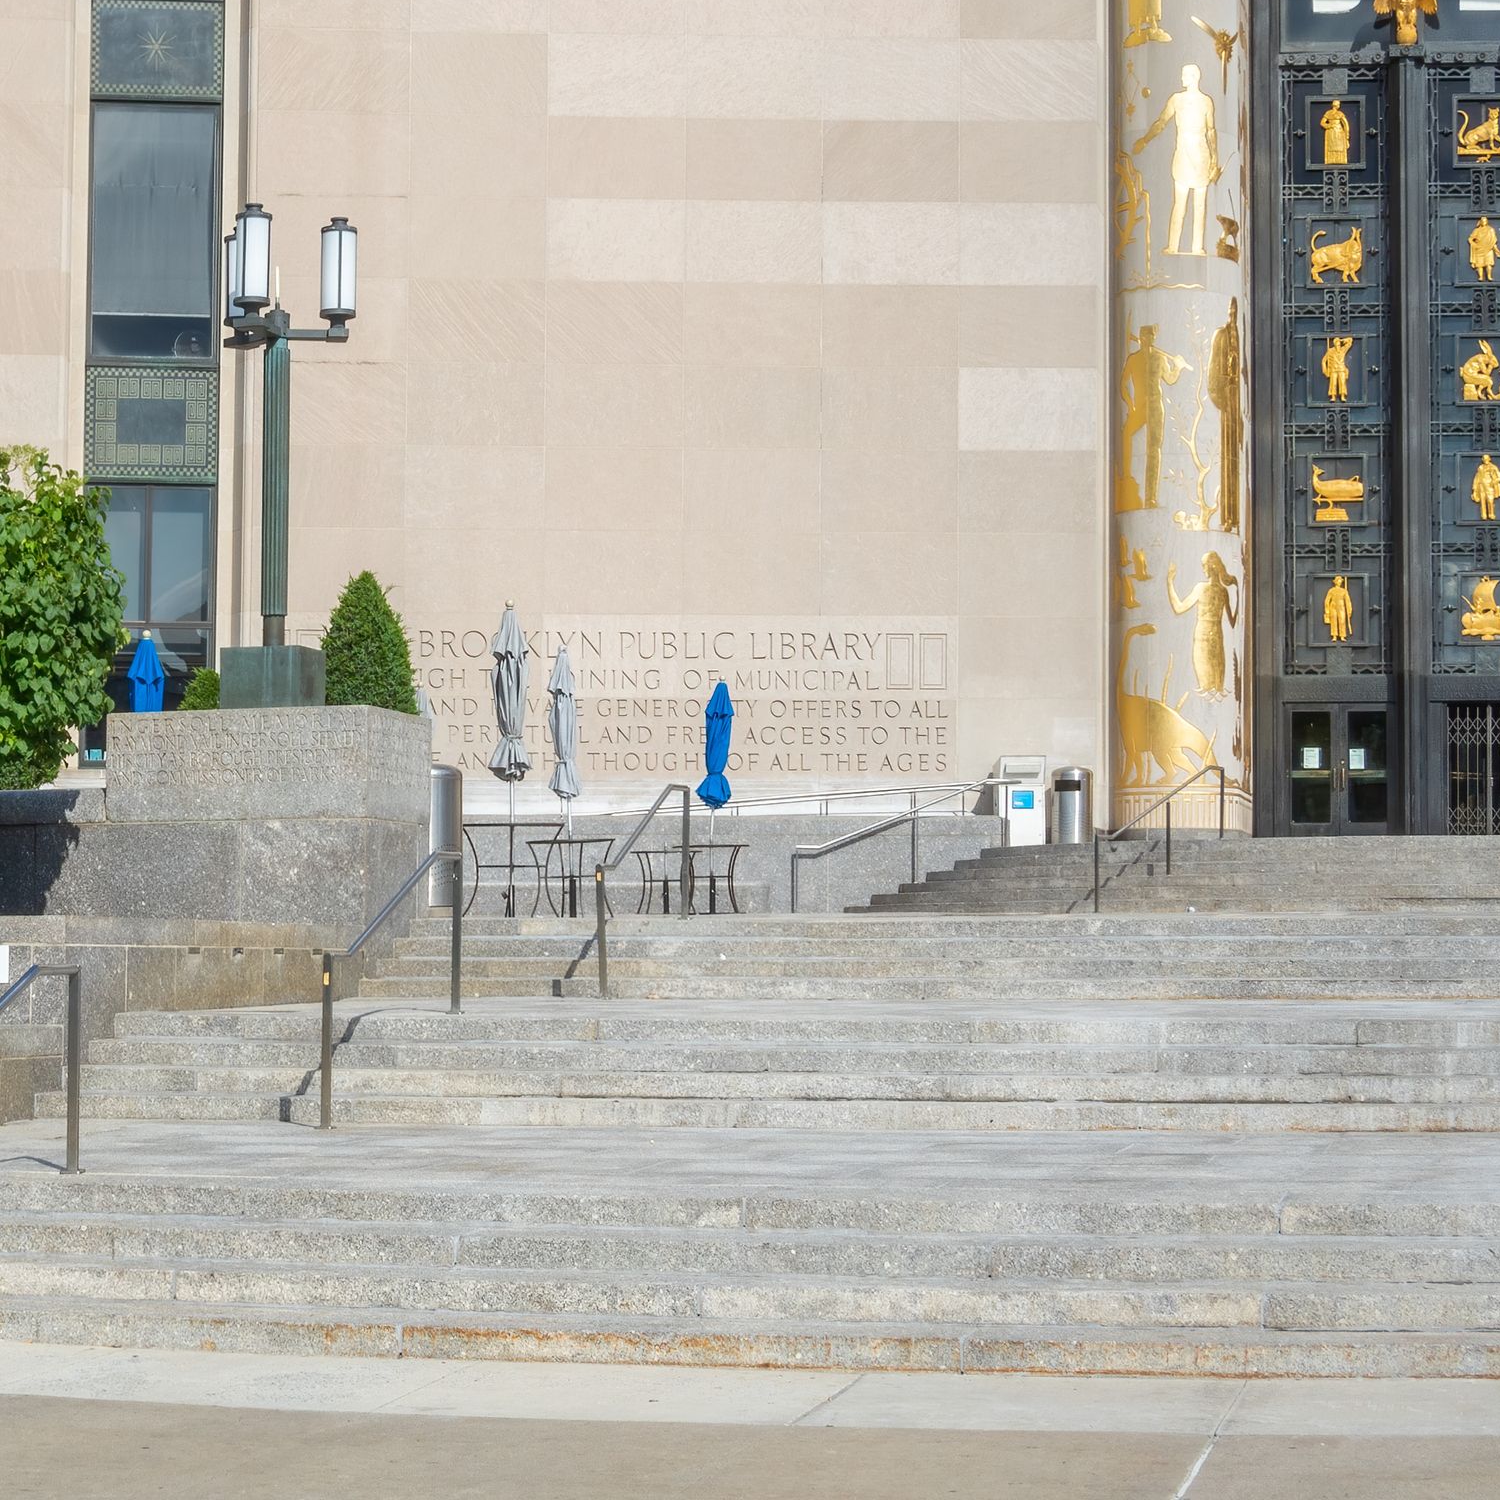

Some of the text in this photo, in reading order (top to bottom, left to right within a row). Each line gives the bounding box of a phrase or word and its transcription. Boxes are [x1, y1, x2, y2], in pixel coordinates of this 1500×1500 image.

[419, 630, 882, 660] BROKLYN PUBLIC LIBRARY
[683, 669, 720, 690] OF
[735, 669, 880, 691] MUNICIPAL
[597, 698, 757, 718] GENEROTY
[769, 699, 862, 719] OFFERS
[870, 699, 901, 719] TO
[910, 699, 948, 719] ALL
[111, 712, 362, 735] INGERSOLL MEMORIAL
[600, 725, 652, 744] AND
[666, 725, 708, 745] FRE
[743, 726, 847, 746] ACCESS
[857, 726, 888, 746] TO
[899, 726, 947, 746] THE
[457, 751, 487, 771] AN
[587, 752, 707, 772] THOUGH
[727, 752, 759, 772] OF
[770, 752, 811, 772] ALL
[821, 752, 868, 772] THE
[879, 752, 947, 772] AGES
